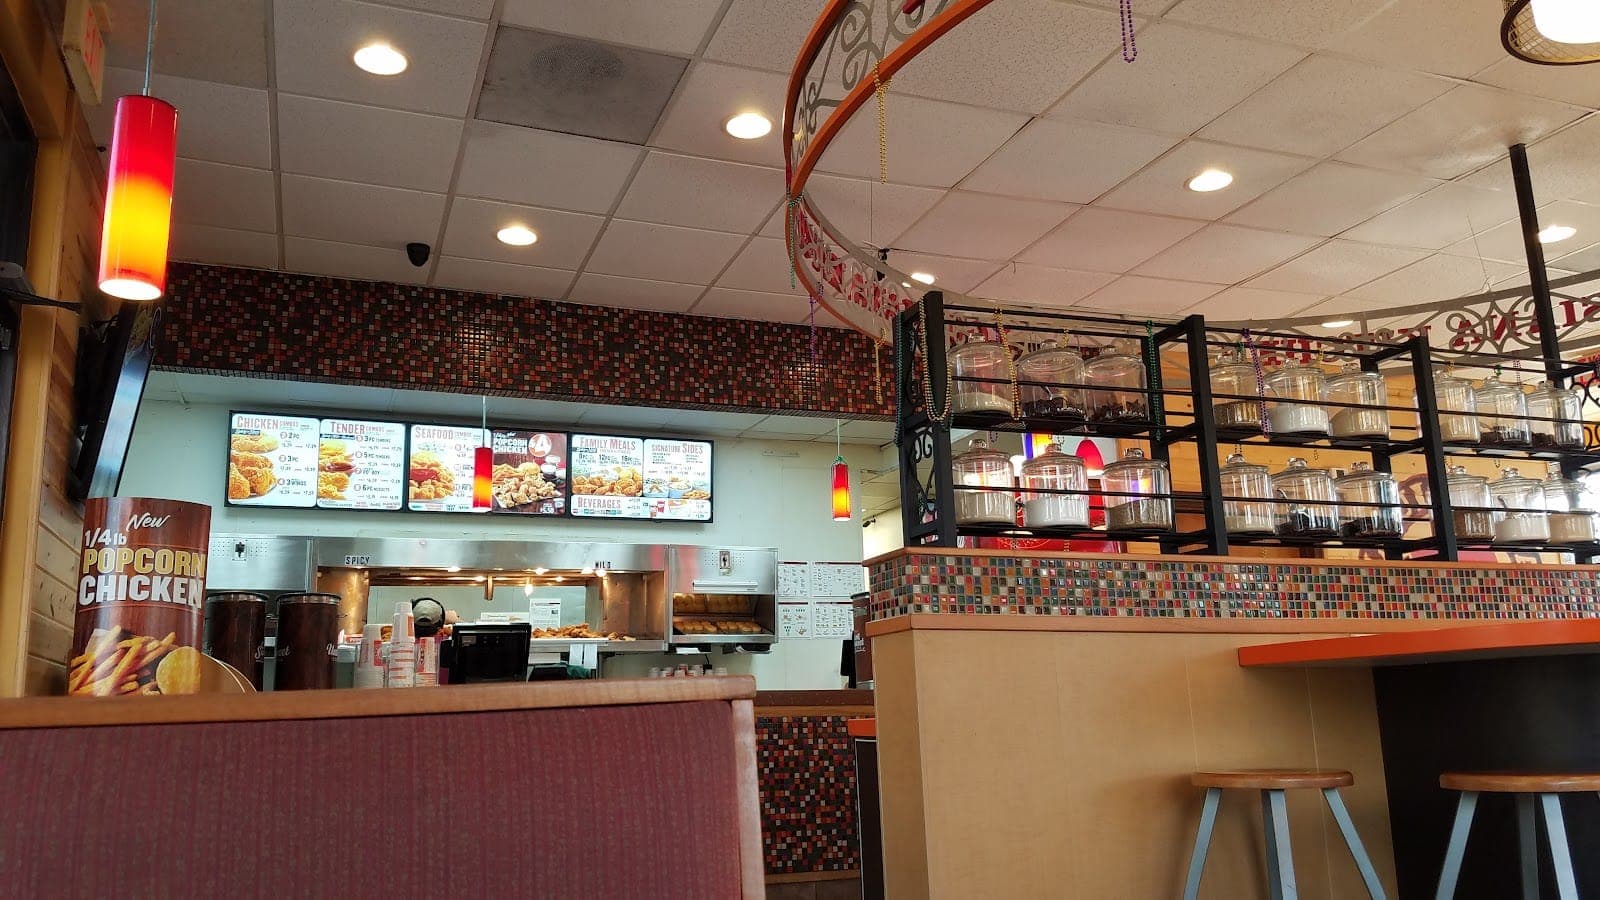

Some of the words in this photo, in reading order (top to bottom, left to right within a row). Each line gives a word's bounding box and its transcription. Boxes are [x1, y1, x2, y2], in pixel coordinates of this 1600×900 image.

[237, 416, 279, 430] CHICKEN
[330, 422, 365, 434] TENDER
[415, 427, 454, 440] SEAFOOD
[580, 437, 607, 448] FAMILY
[610, 439, 636, 450] MEALS
[682, 443, 704, 454] SIDES
[578, 497, 620, 508] BEVERAGES
[126, 512, 171, 532] New
[85, 528, 111, 548] 1/4
[83, 548, 206, 577] POPCORN
[346, 556, 370, 565] SPICY
[79, 575, 203, 608] CHICKEN
